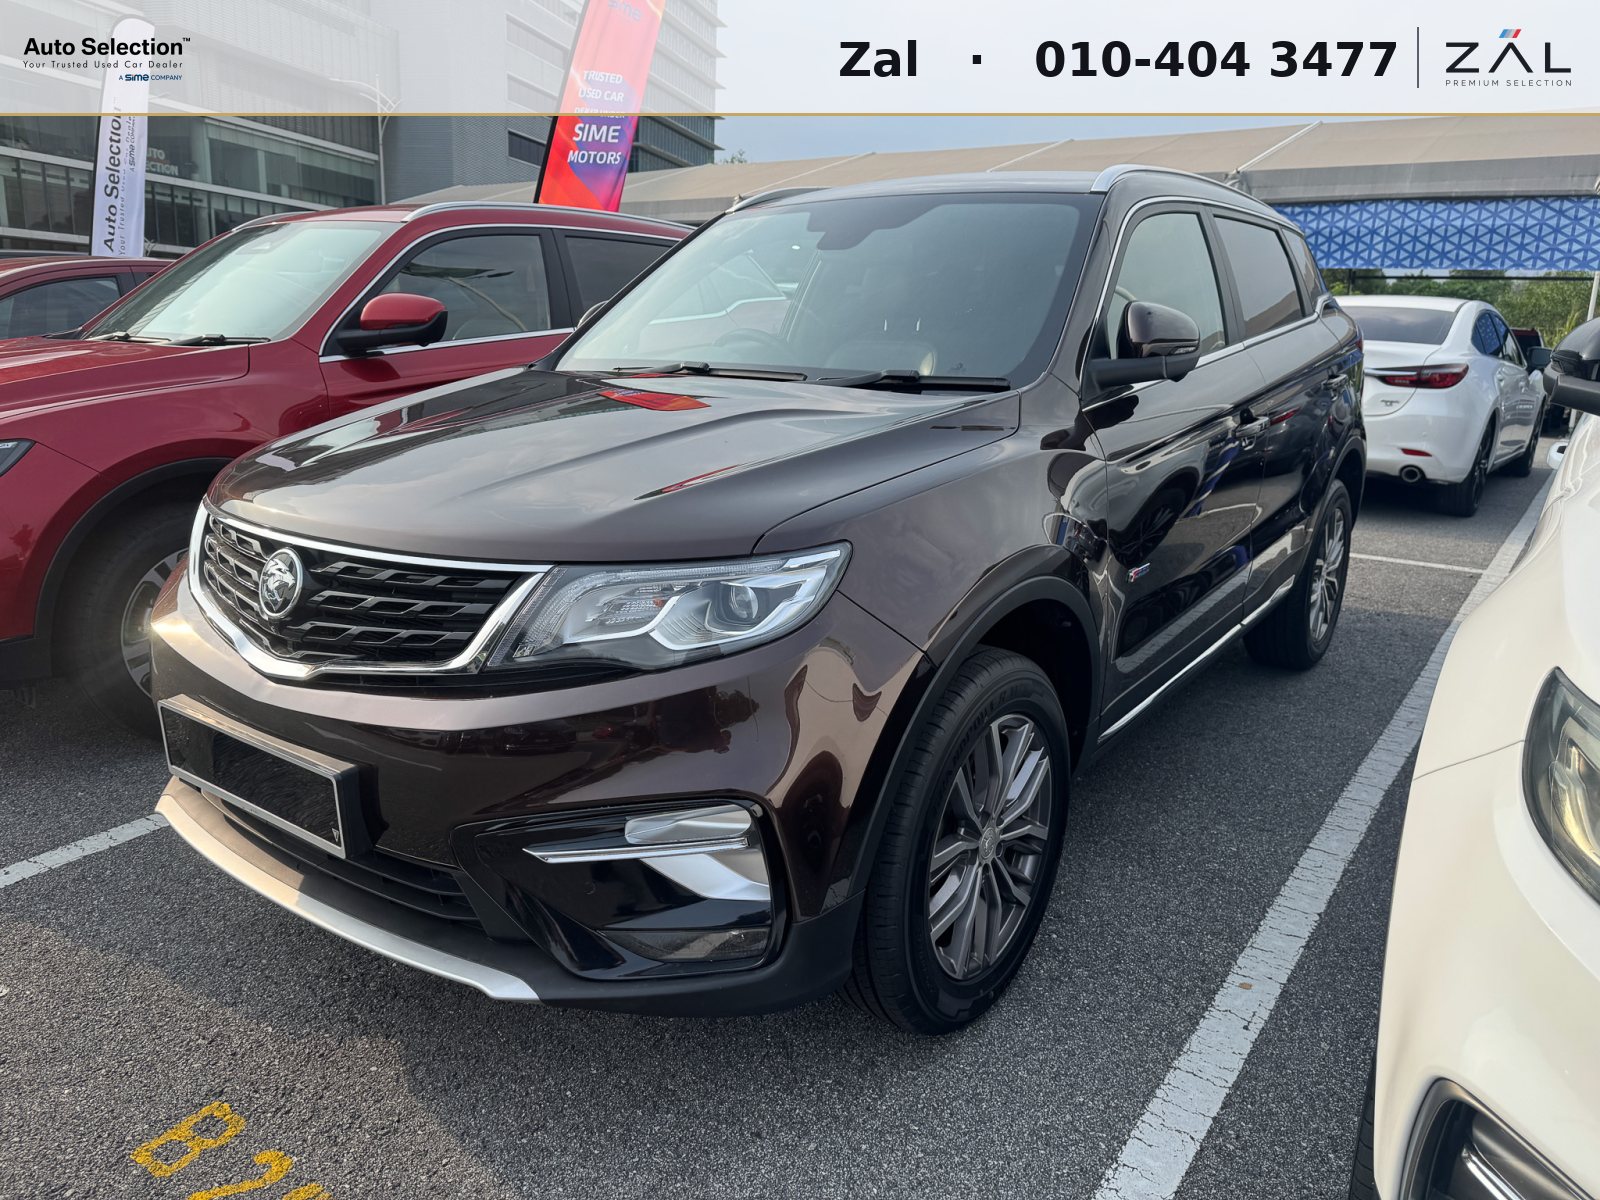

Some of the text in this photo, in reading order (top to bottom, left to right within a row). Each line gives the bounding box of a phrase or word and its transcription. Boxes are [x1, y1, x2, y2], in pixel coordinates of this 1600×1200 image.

[583, 70, 624, 84] TRUSTED
[578, 87, 625, 103] USED CAR
[572, 122, 621, 143] SIME
[567, 150, 622, 165] MOTORS
[103, 204, 118, 253] Auto
[130, 1101, 332, 1200] B2
